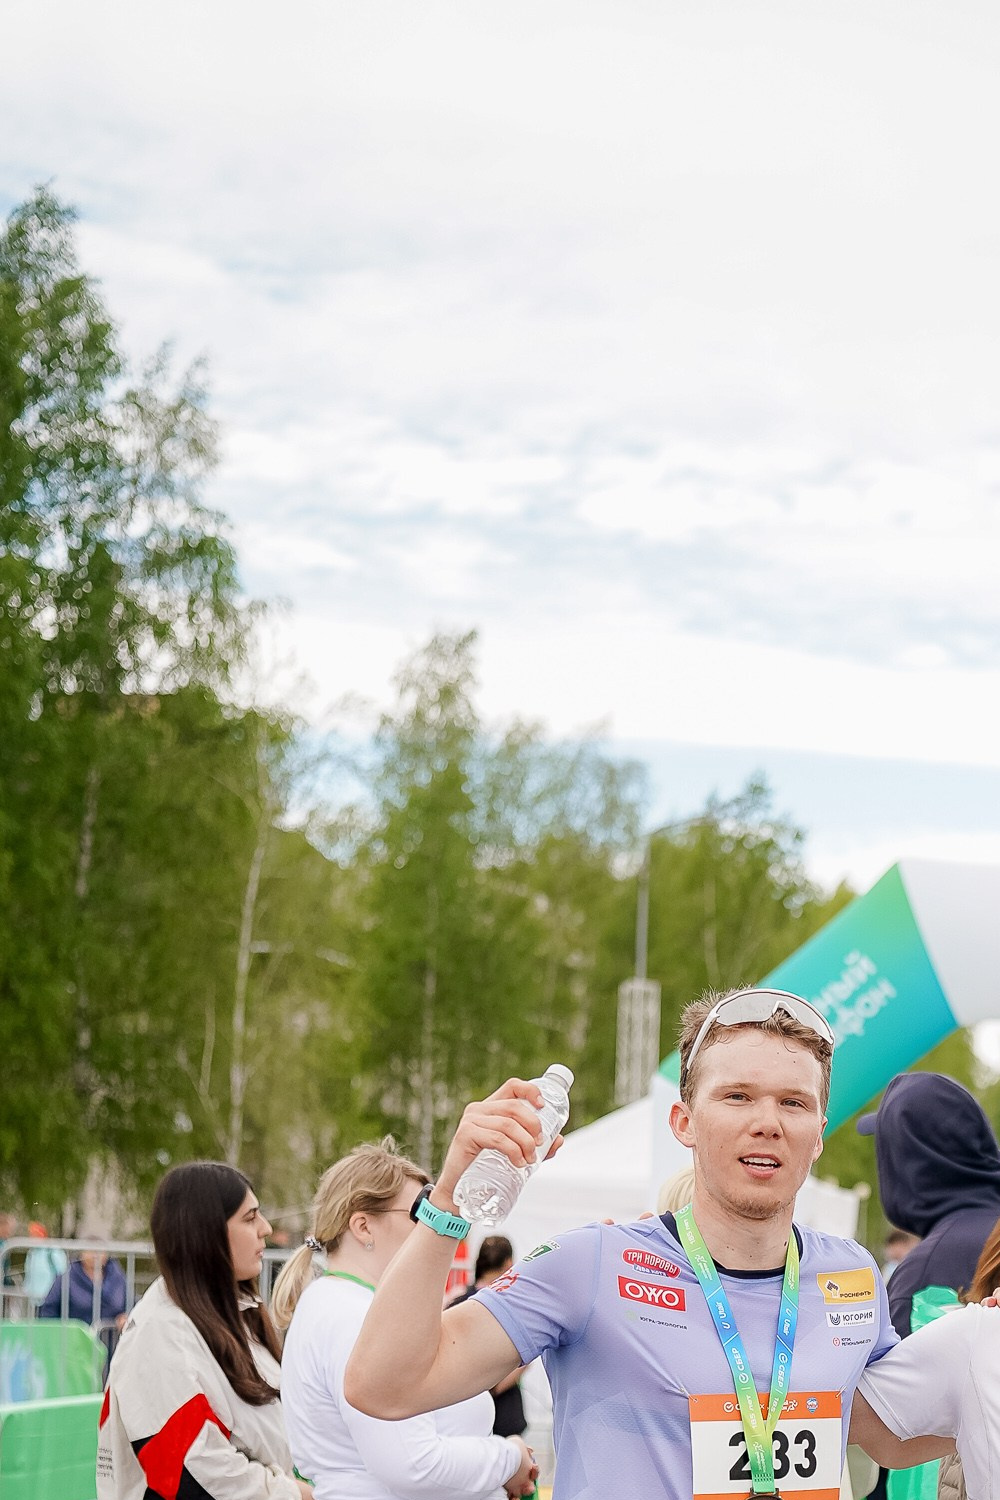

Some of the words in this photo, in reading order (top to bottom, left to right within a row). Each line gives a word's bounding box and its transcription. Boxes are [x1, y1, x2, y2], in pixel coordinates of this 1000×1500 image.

[627, 1251, 643, 1262] ТРИ
[839, 1290, 872, 1298] РОСНЕФТЬ
[842, 1311, 873, 1322] ЮГОРИЯ
[732, 1347, 745, 1371] СБЕР
[778, 1365, 786, 1388] СБЕР
[728, 1429, 817, 1481] 233
